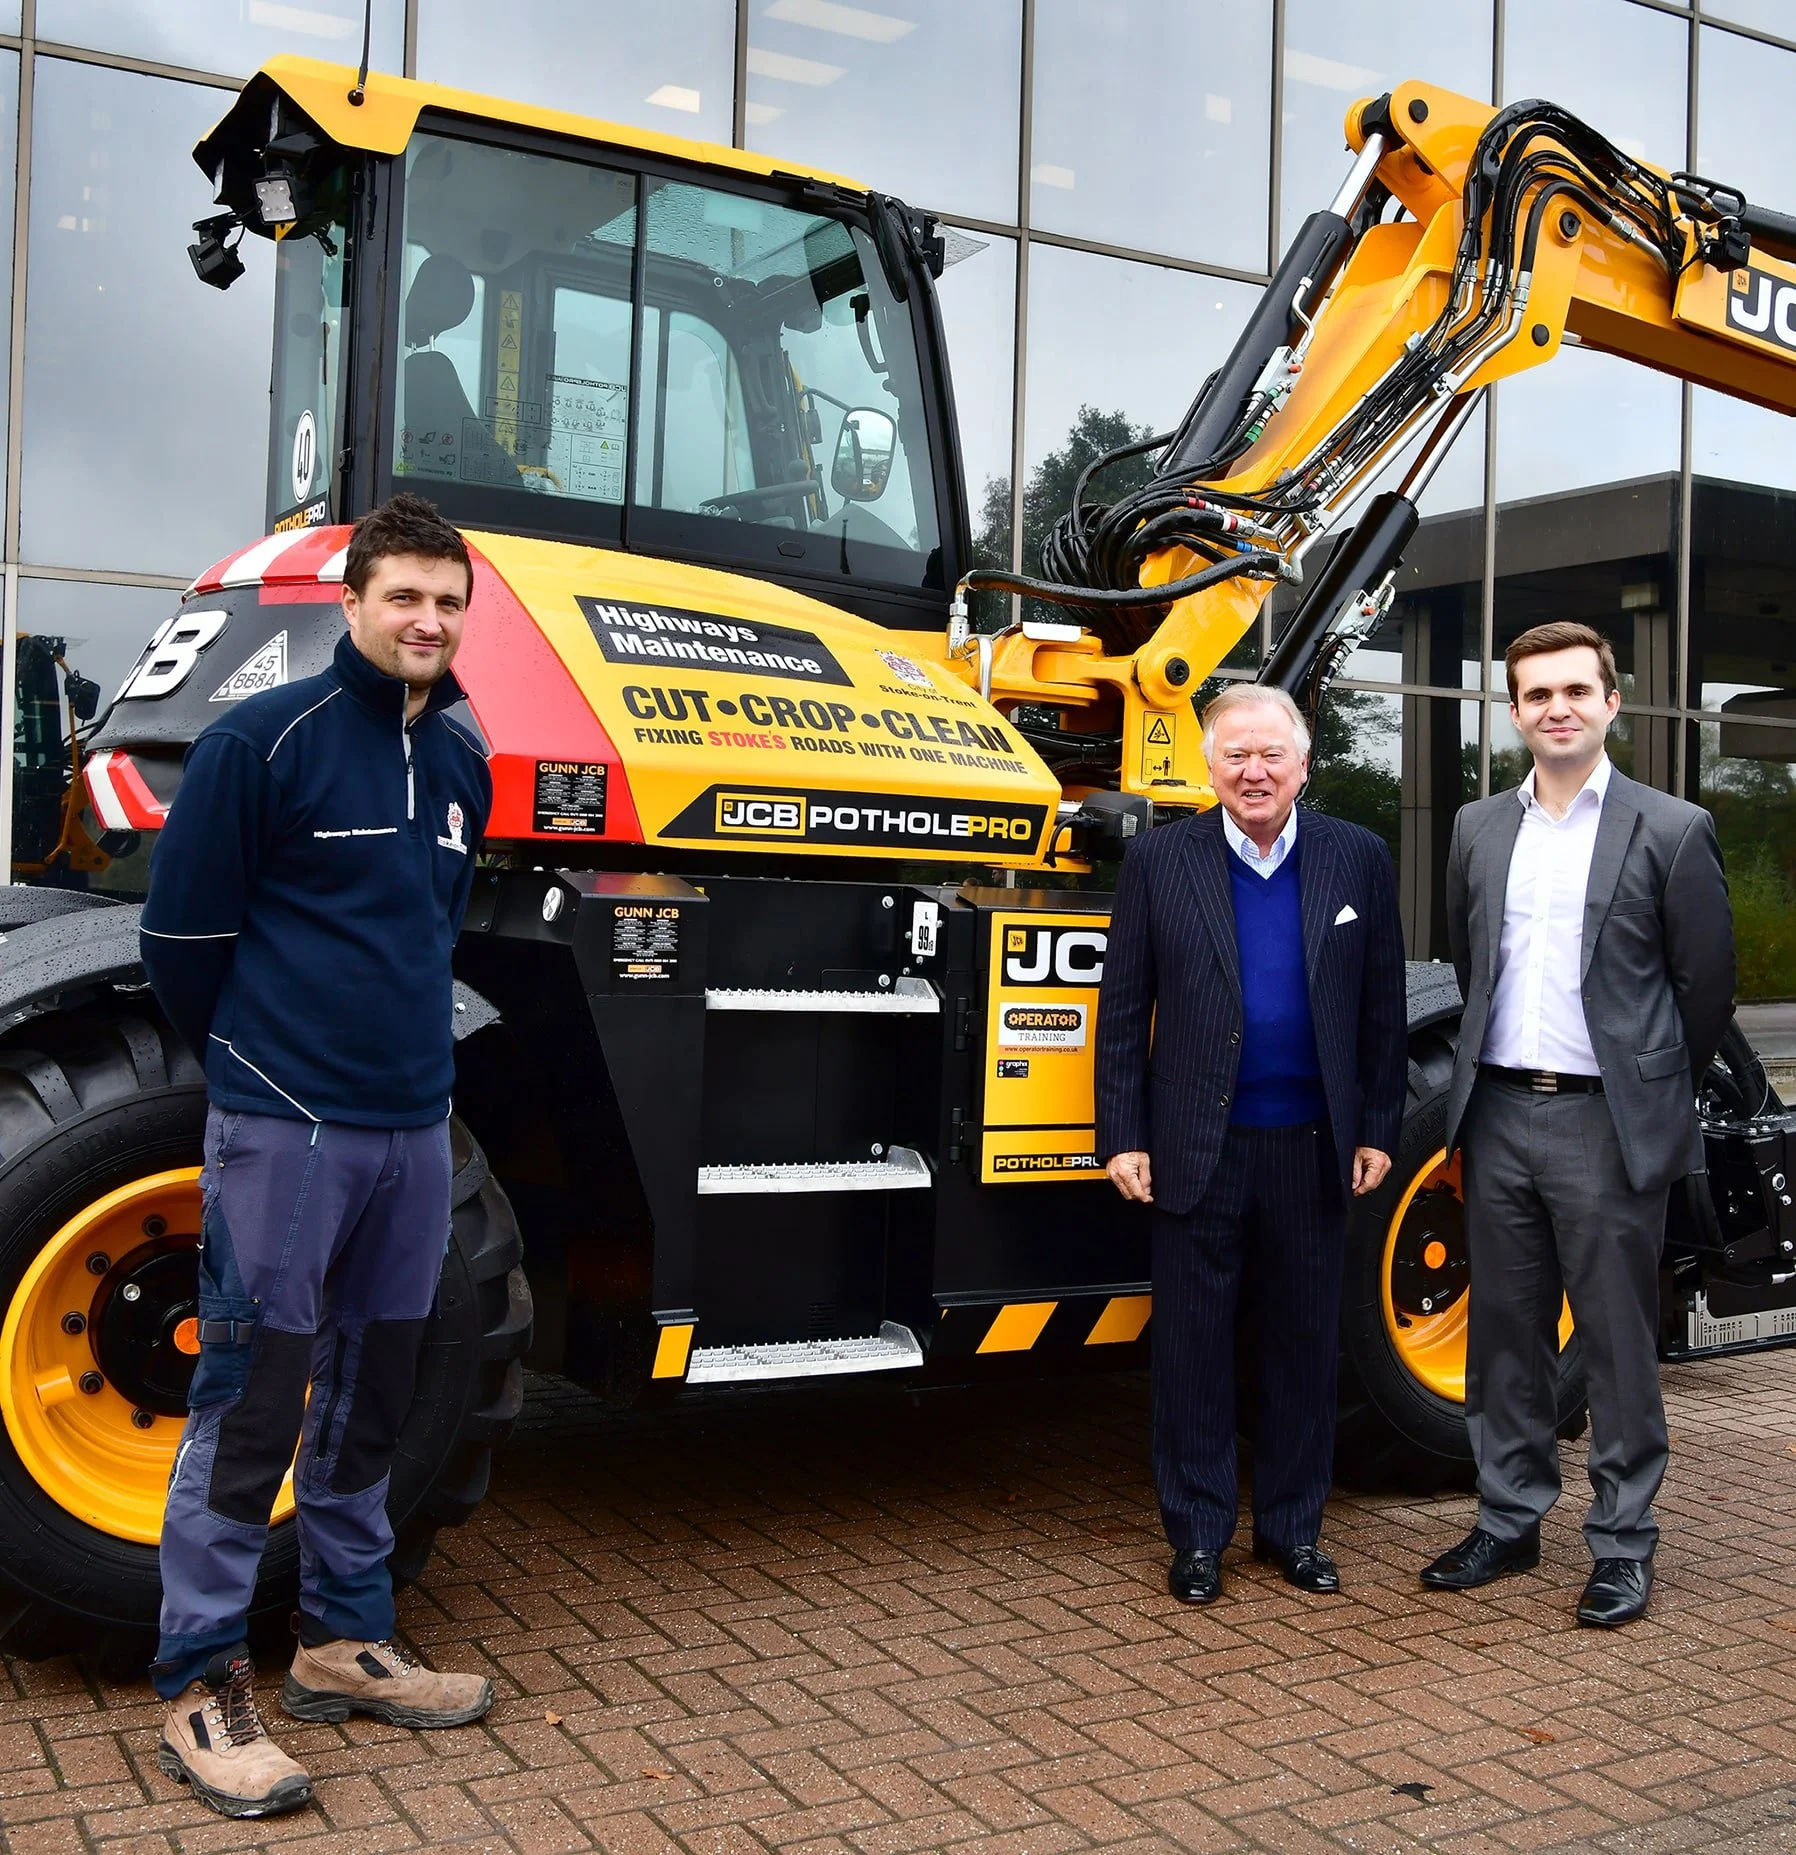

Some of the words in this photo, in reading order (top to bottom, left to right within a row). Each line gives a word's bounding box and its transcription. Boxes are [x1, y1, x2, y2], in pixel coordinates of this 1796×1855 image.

[296, 428, 311, 484] 40
[597, 604, 758, 642] Highways
[610, 632, 822, 674] Maintenance
[254, 656, 278, 671] 45
[233, 672, 276, 689] BB8A
[879, 684, 977, 708] Stoke-on-Trent
[622, 686, 710, 722] CUT
[739, 693, 856, 732] CROP
[882, 710, 1014, 754] CLEAN
[634, 728, 702, 746] FIXING
[710, 730, 786, 750] STOKE'S
[792, 736, 854, 755] ROADS
[858, 742, 910, 760] WITH
[911, 746, 946, 764] ONE
[952, 752, 1028, 774] MACHINE
[539, 762, 578, 774] GUNN
[581, 765, 606, 776] JCB
[724, 802, 799, 828] JCB
[809, 805, 1032, 841] POTHOLEPRO
[614, 906, 652, 918] GUNN
[656, 908, 679, 919] JCB
[1008, 1012, 1078, 1027] OPERATOR
[1018, 1032, 1066, 1042] TRAINING
[996, 1156, 1100, 1170] POTHOLEPR
